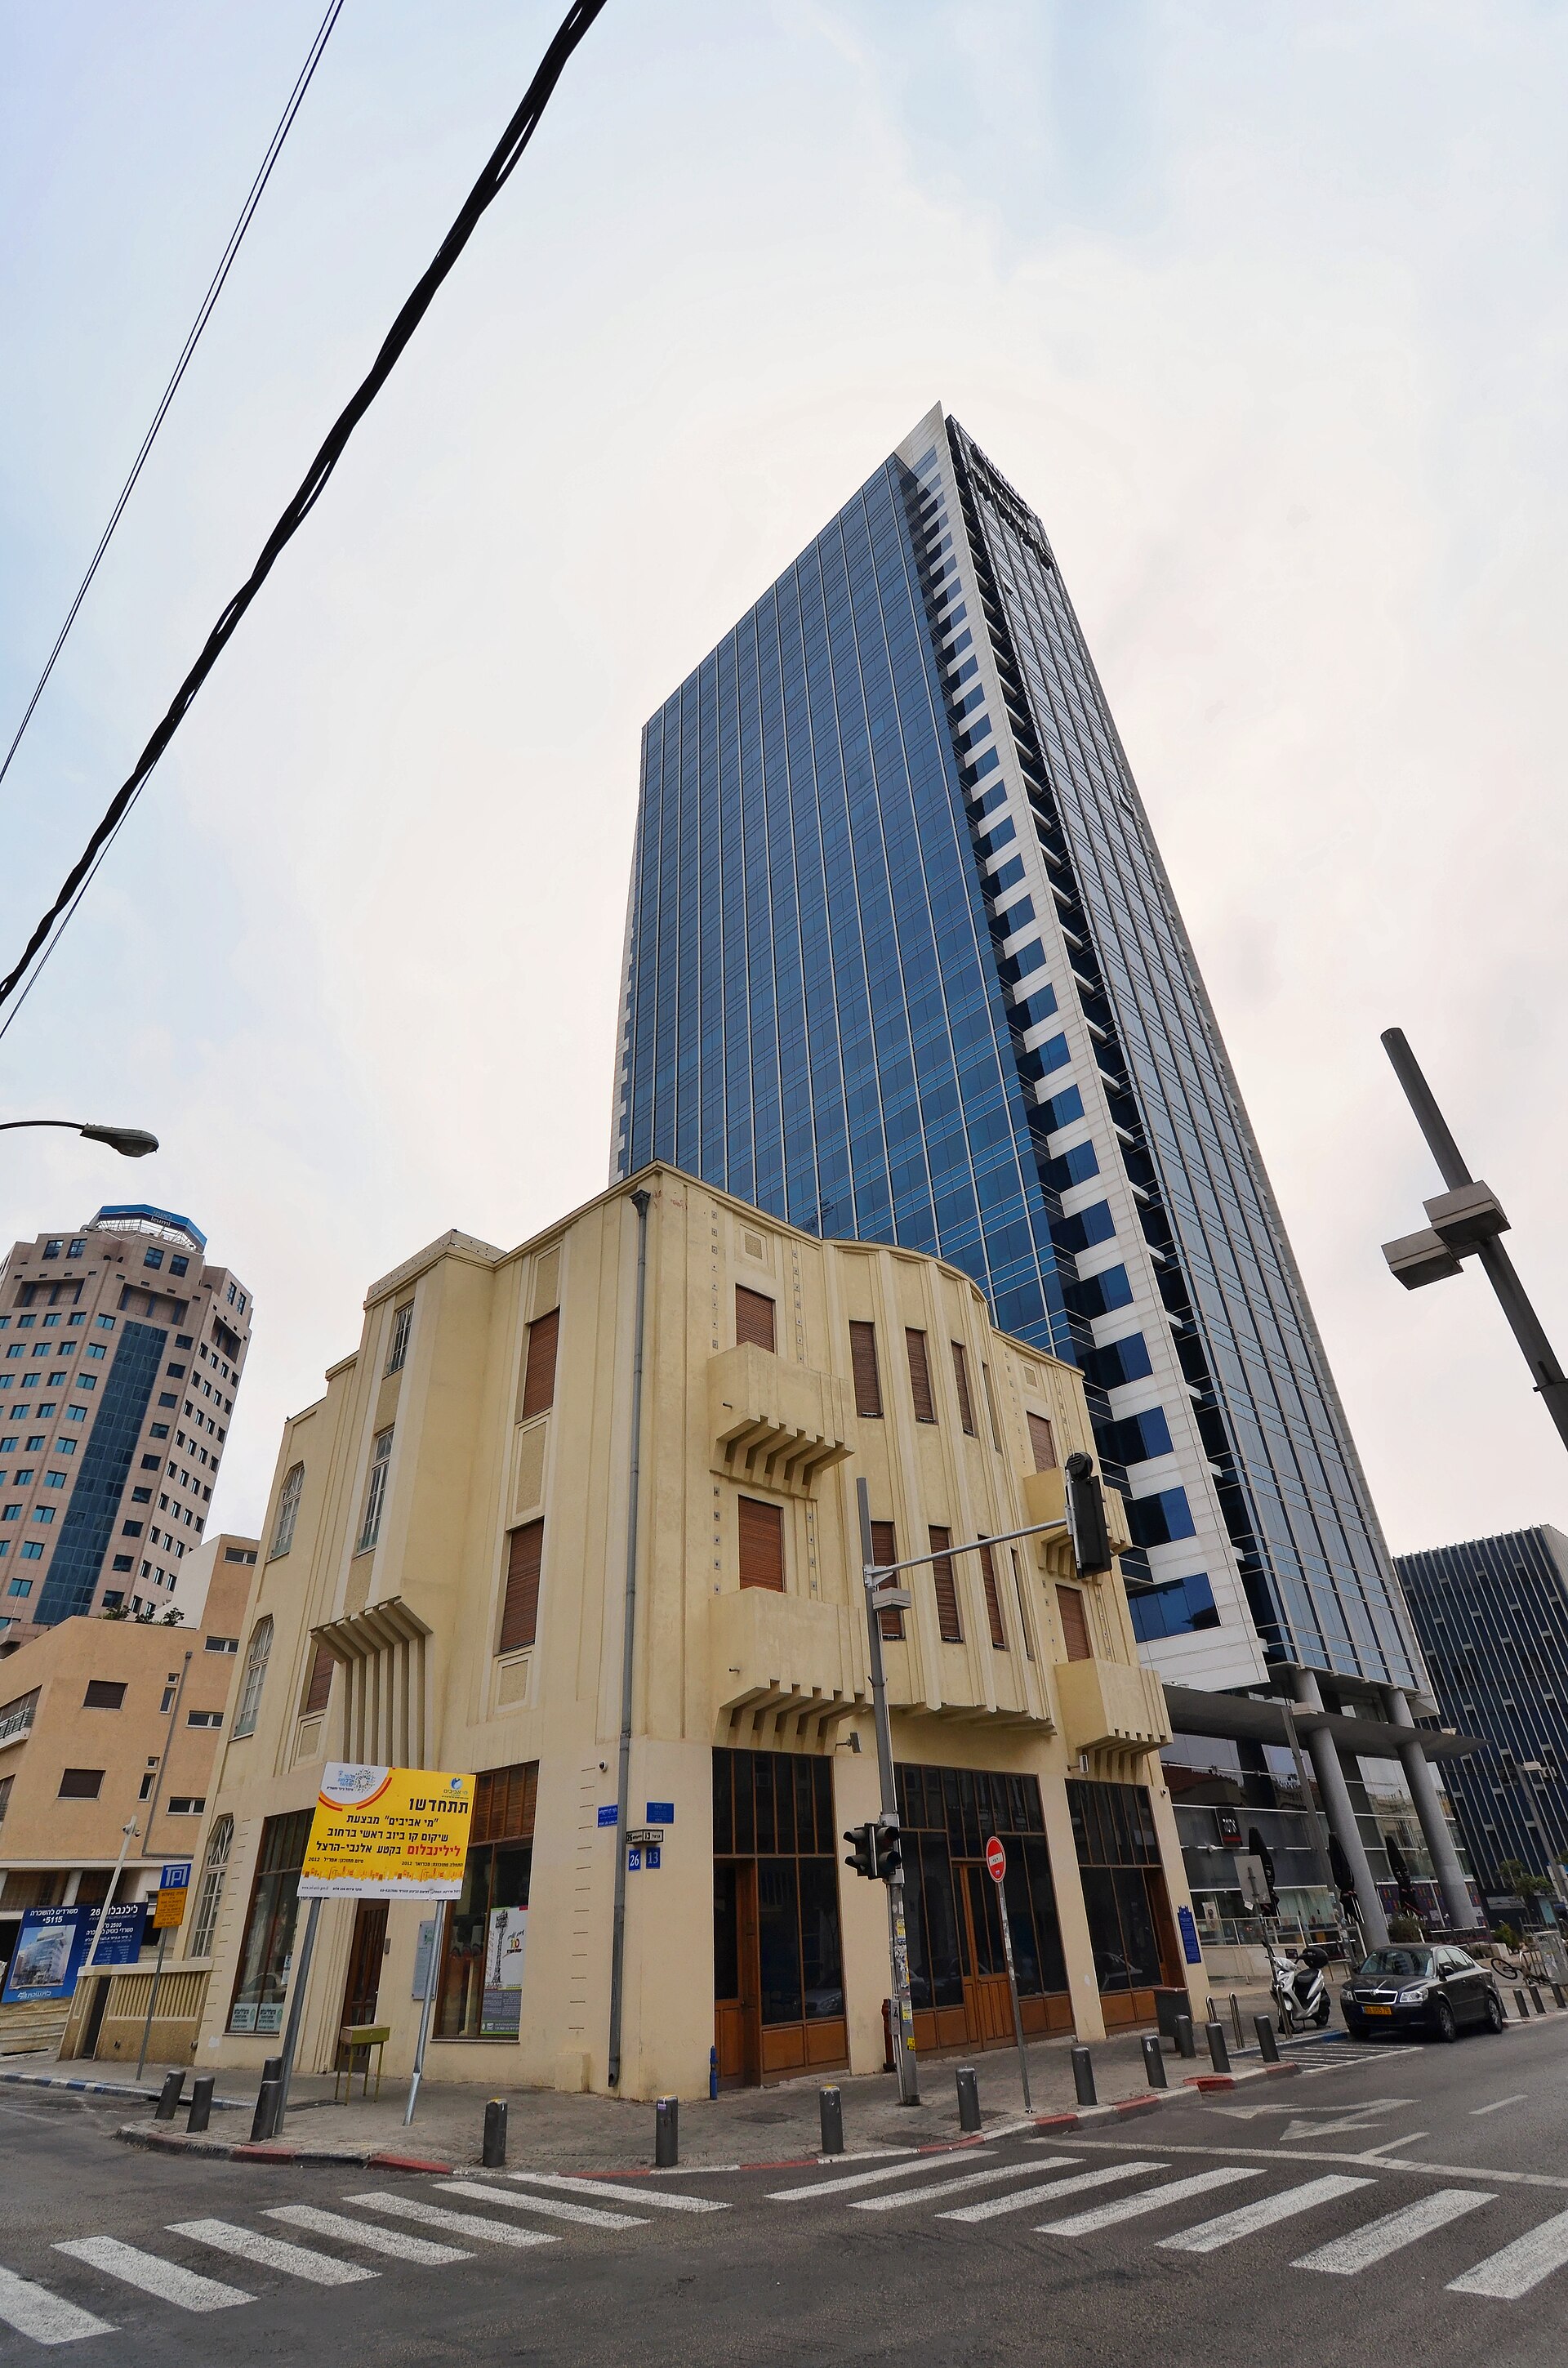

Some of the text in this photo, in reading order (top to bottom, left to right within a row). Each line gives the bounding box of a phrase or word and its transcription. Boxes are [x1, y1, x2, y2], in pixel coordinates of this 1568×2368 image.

[151, 1216, 171, 1227] leumi
[346, 1815, 380, 1825] מבצעת
[327, 1827, 448, 1844] שיקום קו ביוב ראשי ברחוב
[316, 1840, 461, 1857] לילינבלום בקטע אלנבי-הרצל
[630, 1853, 639, 1866] 26
[648, 1852, 659, 1864] 13
[90, 1908, 101, 1916] 28
